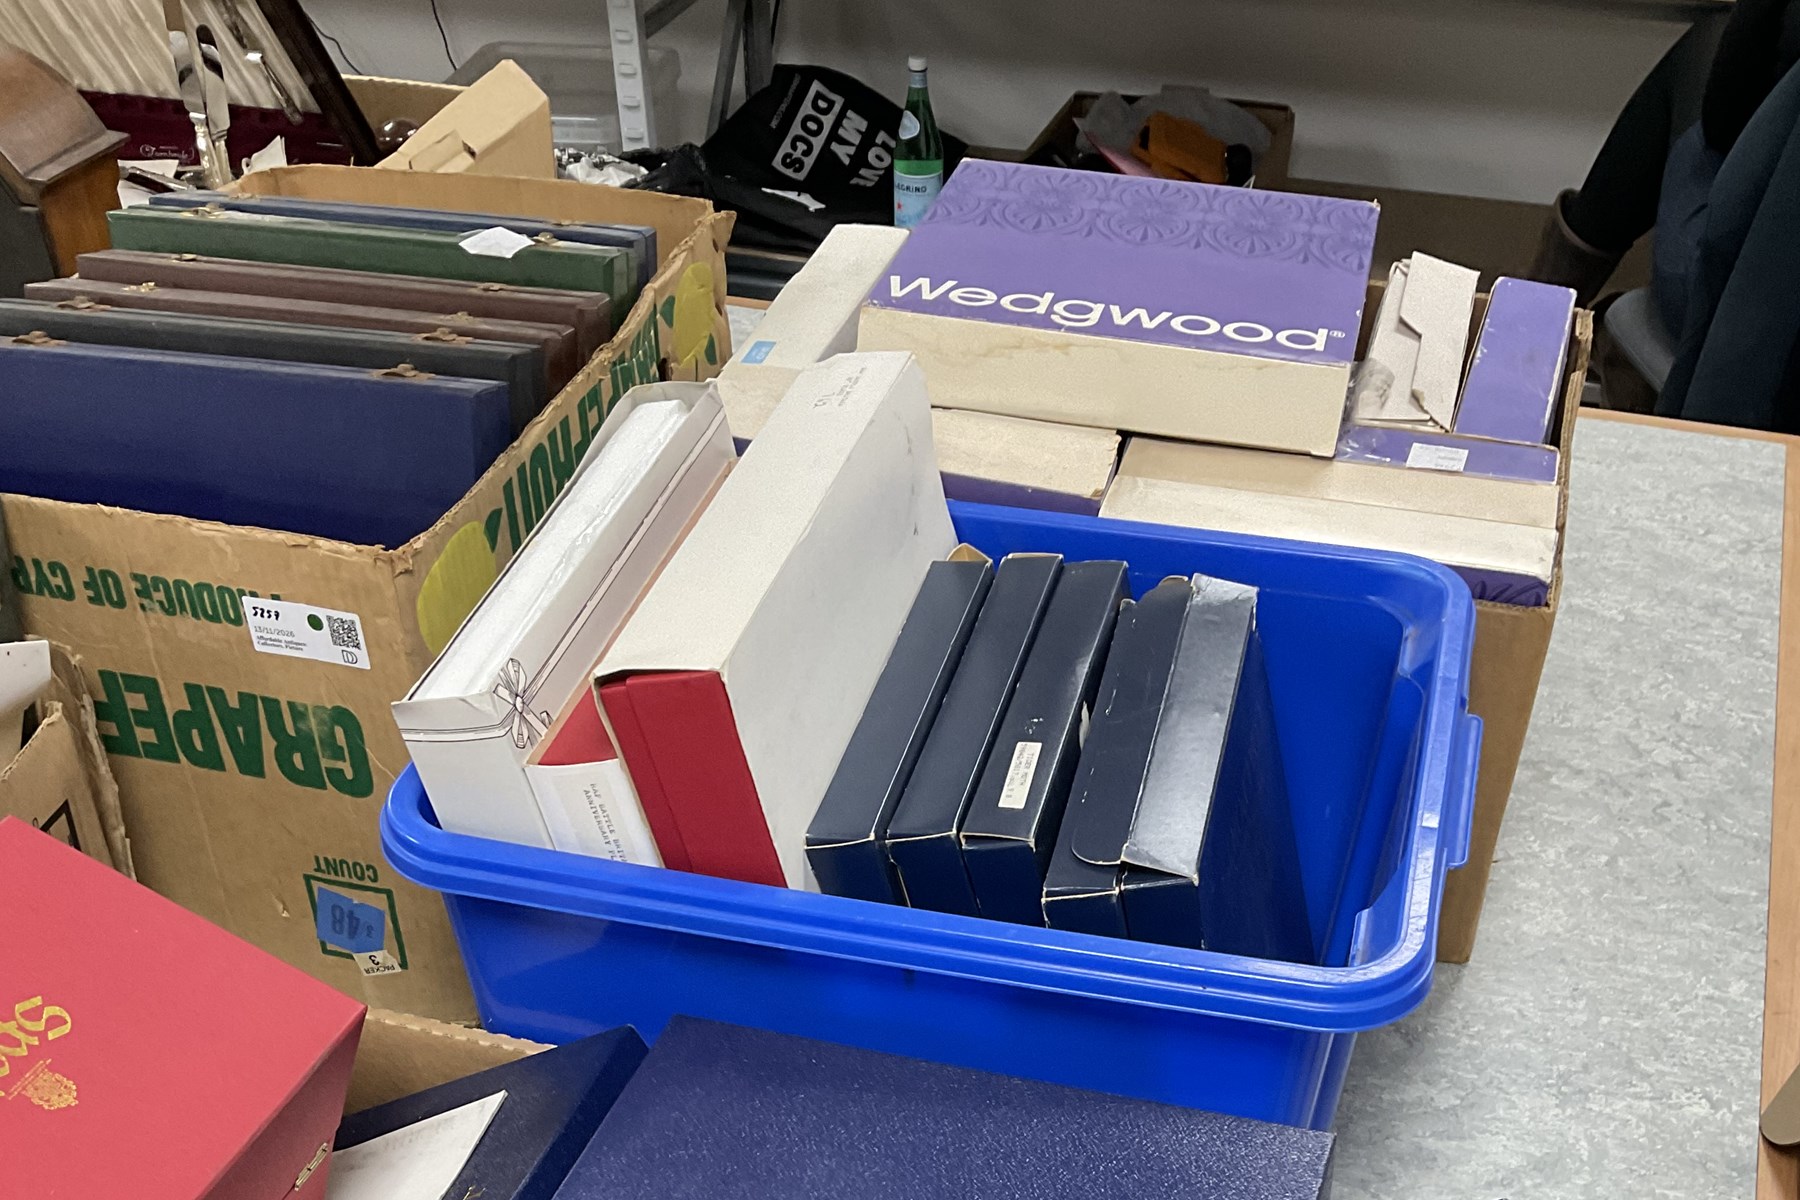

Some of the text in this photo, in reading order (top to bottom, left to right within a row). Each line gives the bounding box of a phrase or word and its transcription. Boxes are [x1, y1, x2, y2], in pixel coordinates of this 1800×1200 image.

[781, 89, 836, 173] DOCS
[830, 109, 868, 166] MY
[83, 566, 127, 610] OF
[313, 855, 379, 883] COUNT
[363, 964, 395, 975] PACKER
[368, 954, 380, 966] 3
